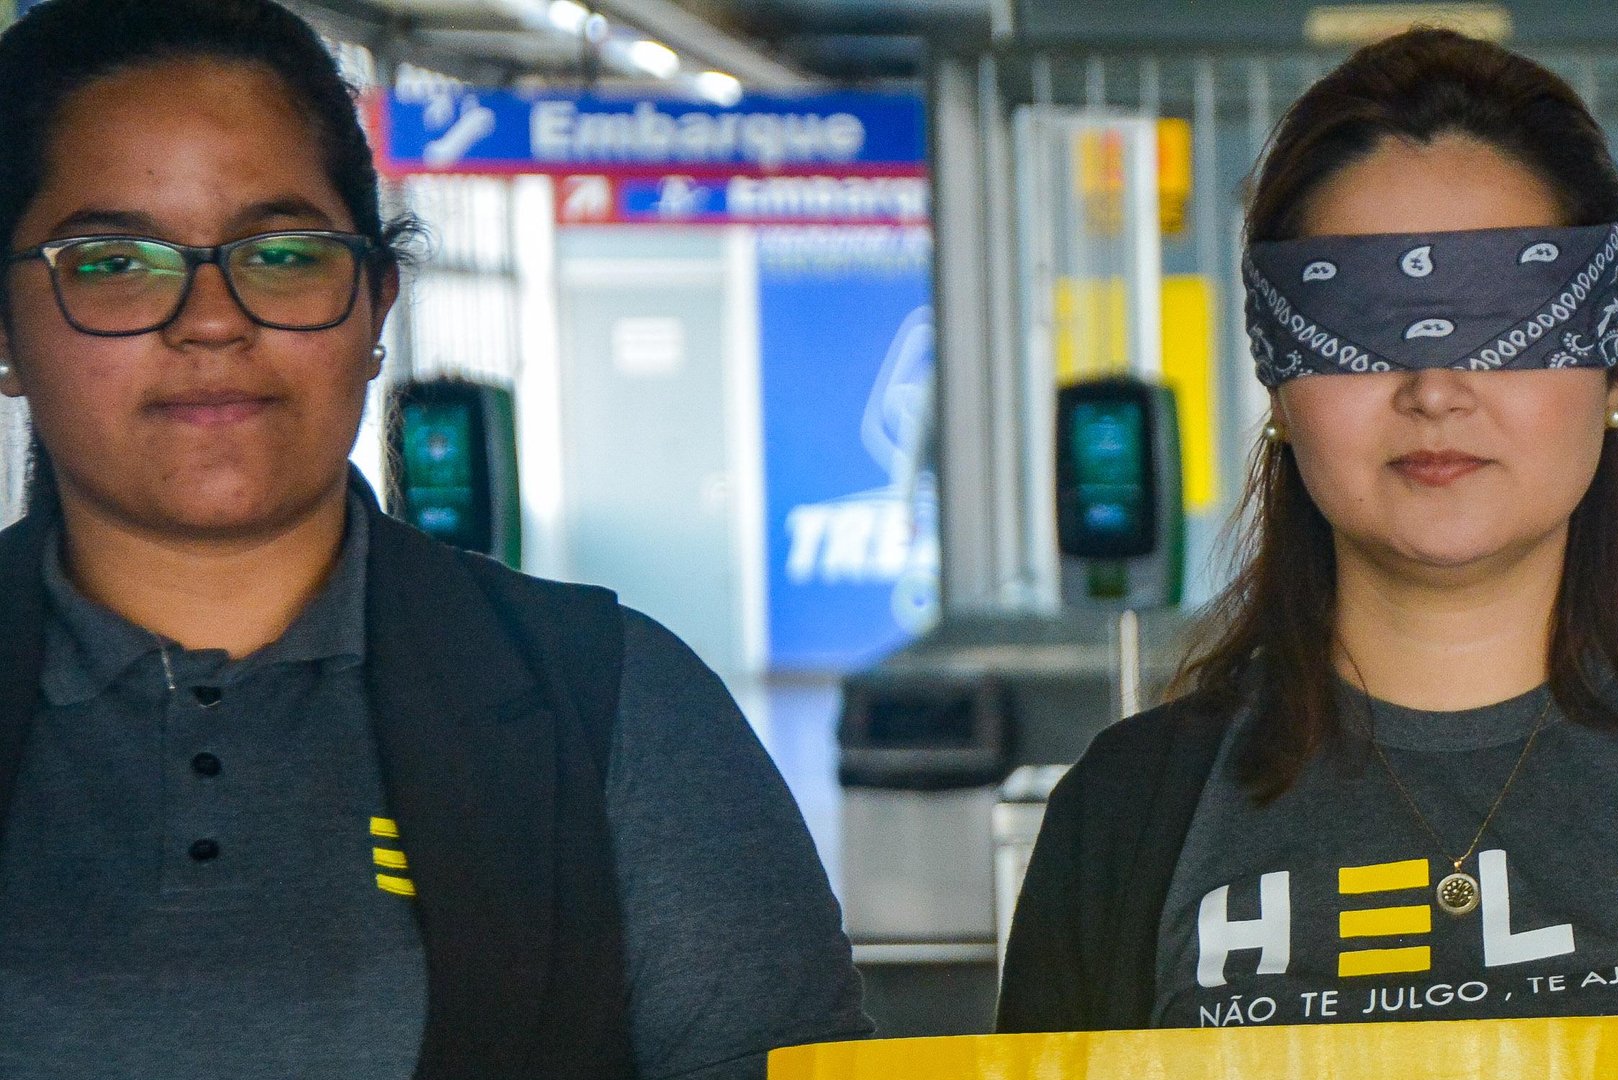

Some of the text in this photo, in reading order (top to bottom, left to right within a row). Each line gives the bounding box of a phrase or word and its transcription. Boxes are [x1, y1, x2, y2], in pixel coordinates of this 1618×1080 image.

[528, 99, 868, 170] Embarque
[1199, 995, 1277, 1028] NÃO
[1300, 990, 1339, 1018] TE
[1526, 974, 1565, 994] TE
